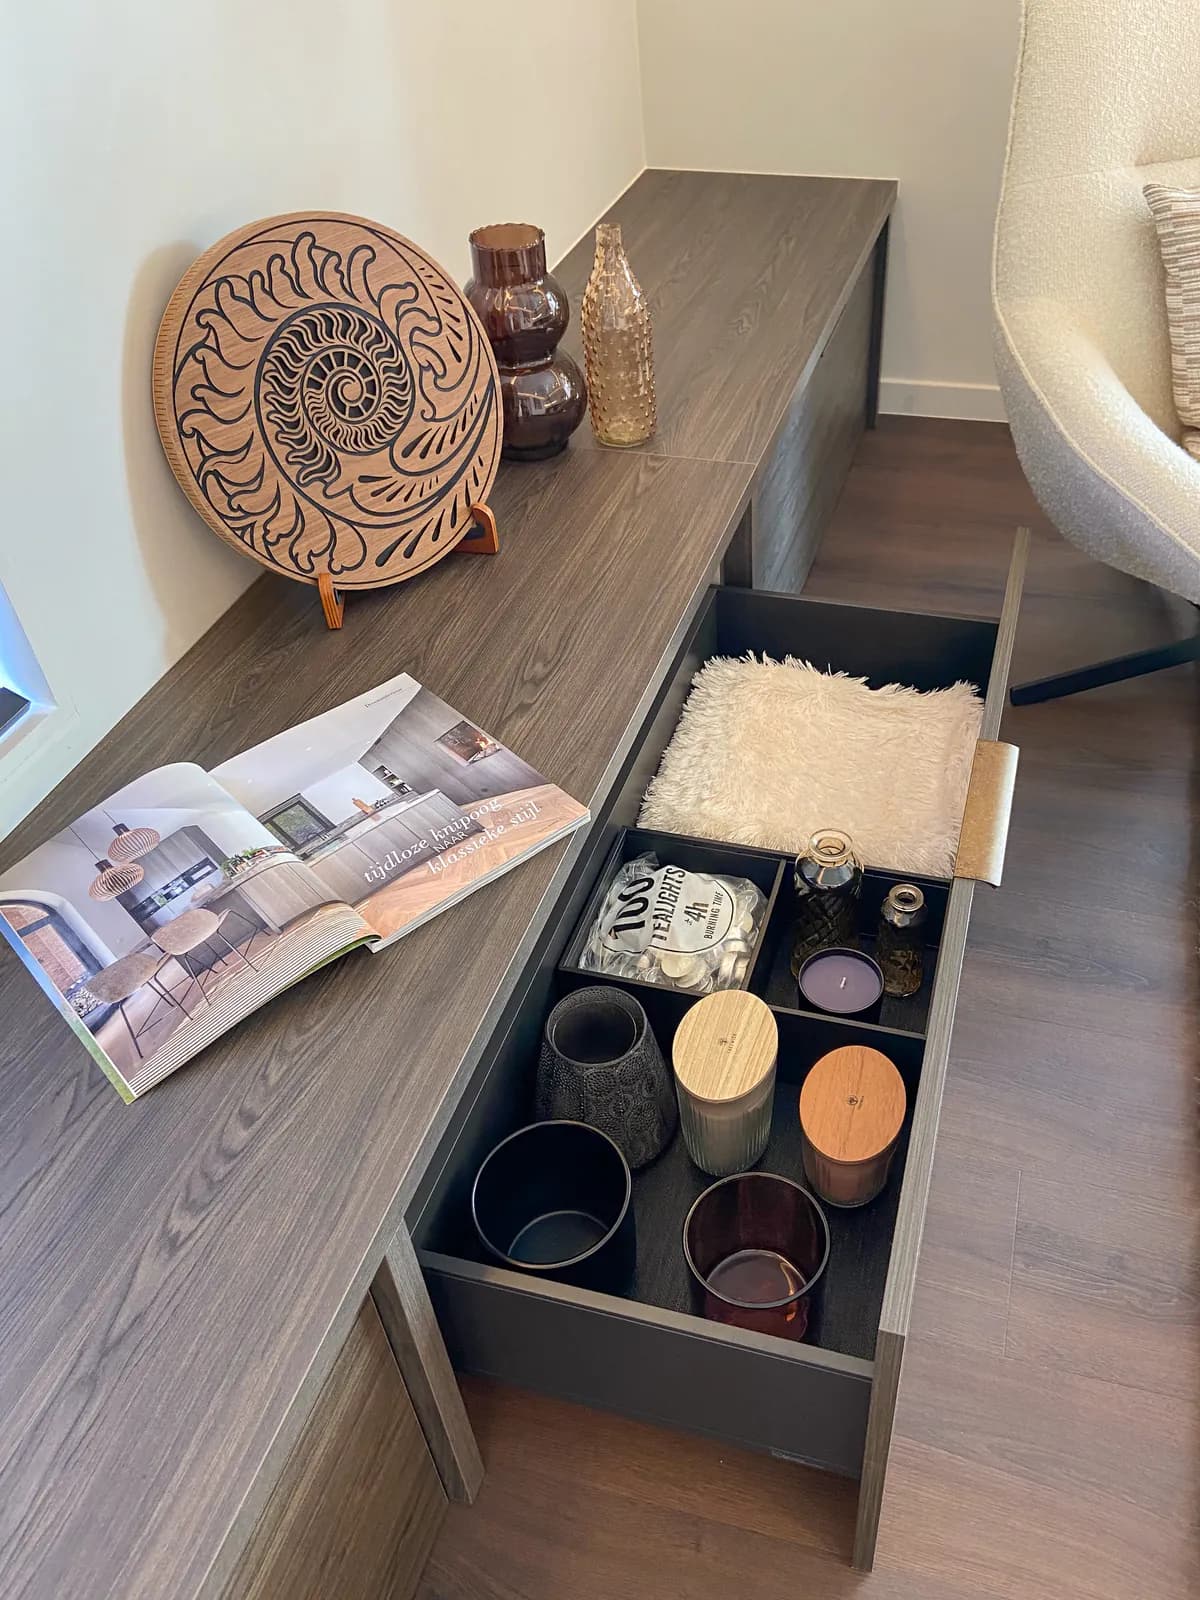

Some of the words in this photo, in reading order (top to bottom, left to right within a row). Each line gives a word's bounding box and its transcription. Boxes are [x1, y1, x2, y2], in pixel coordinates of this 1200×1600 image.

[364, 838, 430, 883] tijdloze
[430, 798, 503, 842] knipoog
[427, 825, 505, 874] klassieke
[509, 800, 542, 826] stijl
[433, 831, 468, 853] NAAR
[607, 877, 655, 940] 100
[703, 908, 720, 940] BURNING
[712, 891, 724, 906] TIME
